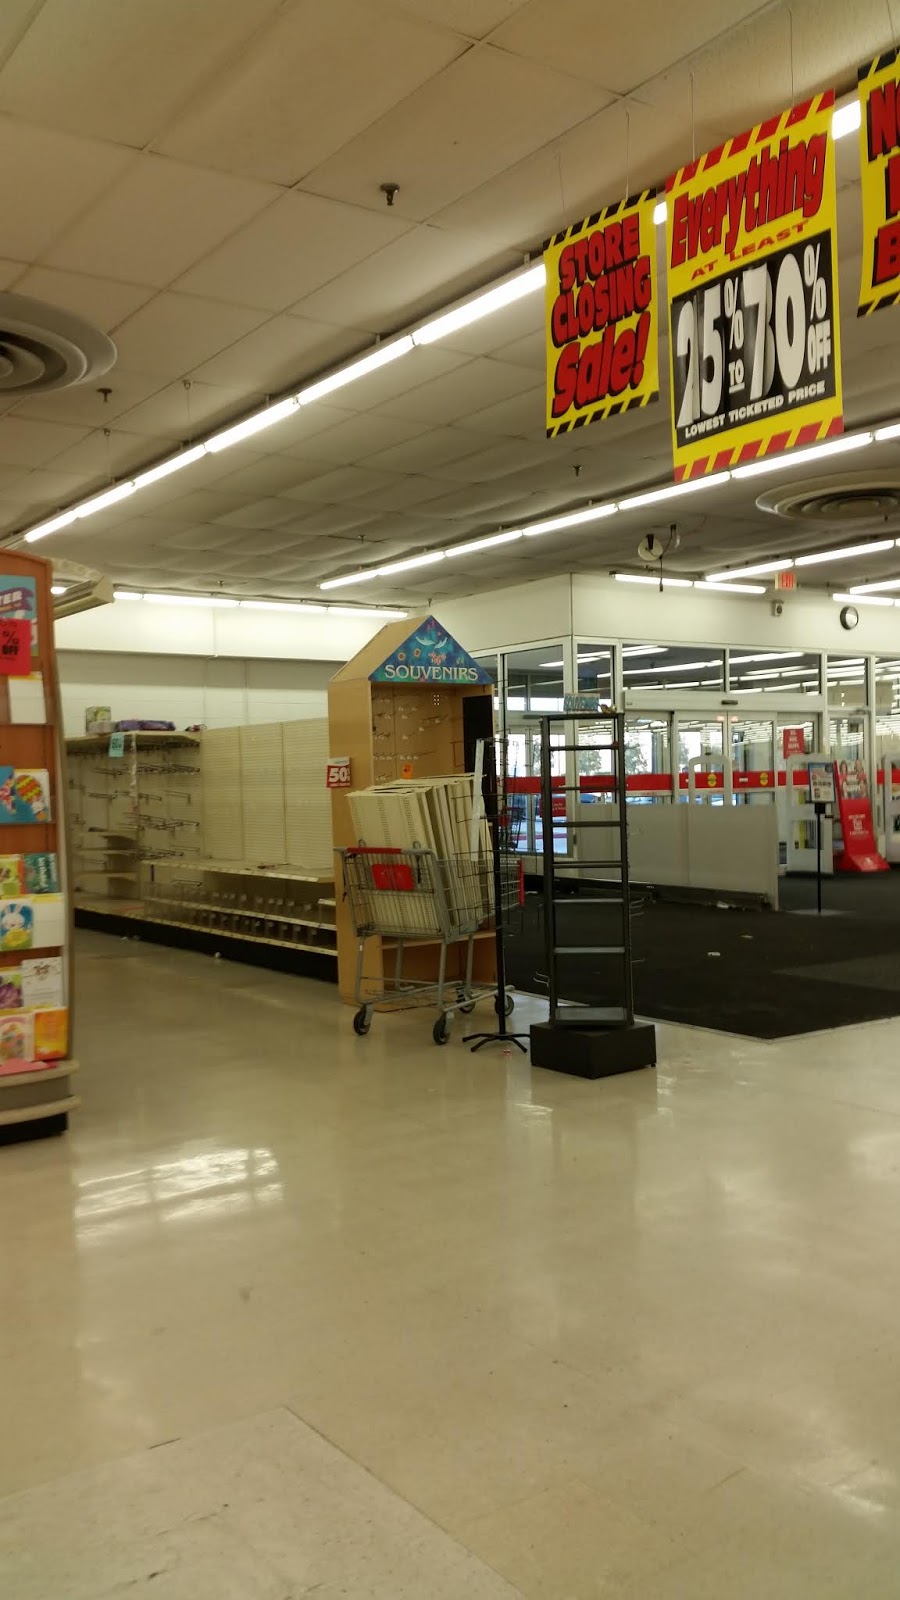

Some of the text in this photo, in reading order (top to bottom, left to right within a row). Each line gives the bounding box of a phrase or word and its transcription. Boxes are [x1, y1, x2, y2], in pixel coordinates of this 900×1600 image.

[671, 133, 827, 269] Everything
[560, 211, 641, 294] STORE
[690, 220, 809, 281] AT LEAST
[552, 255, 652, 348] CLOSING
[551, 310, 652, 419] Sale!
[728, 358, 745, 388] TO
[807, 319, 832, 375] OFF
[685, 380, 826, 439] LOWEST TICKETED PRICE
[385, 664, 479, 682] SOUVENIRS
